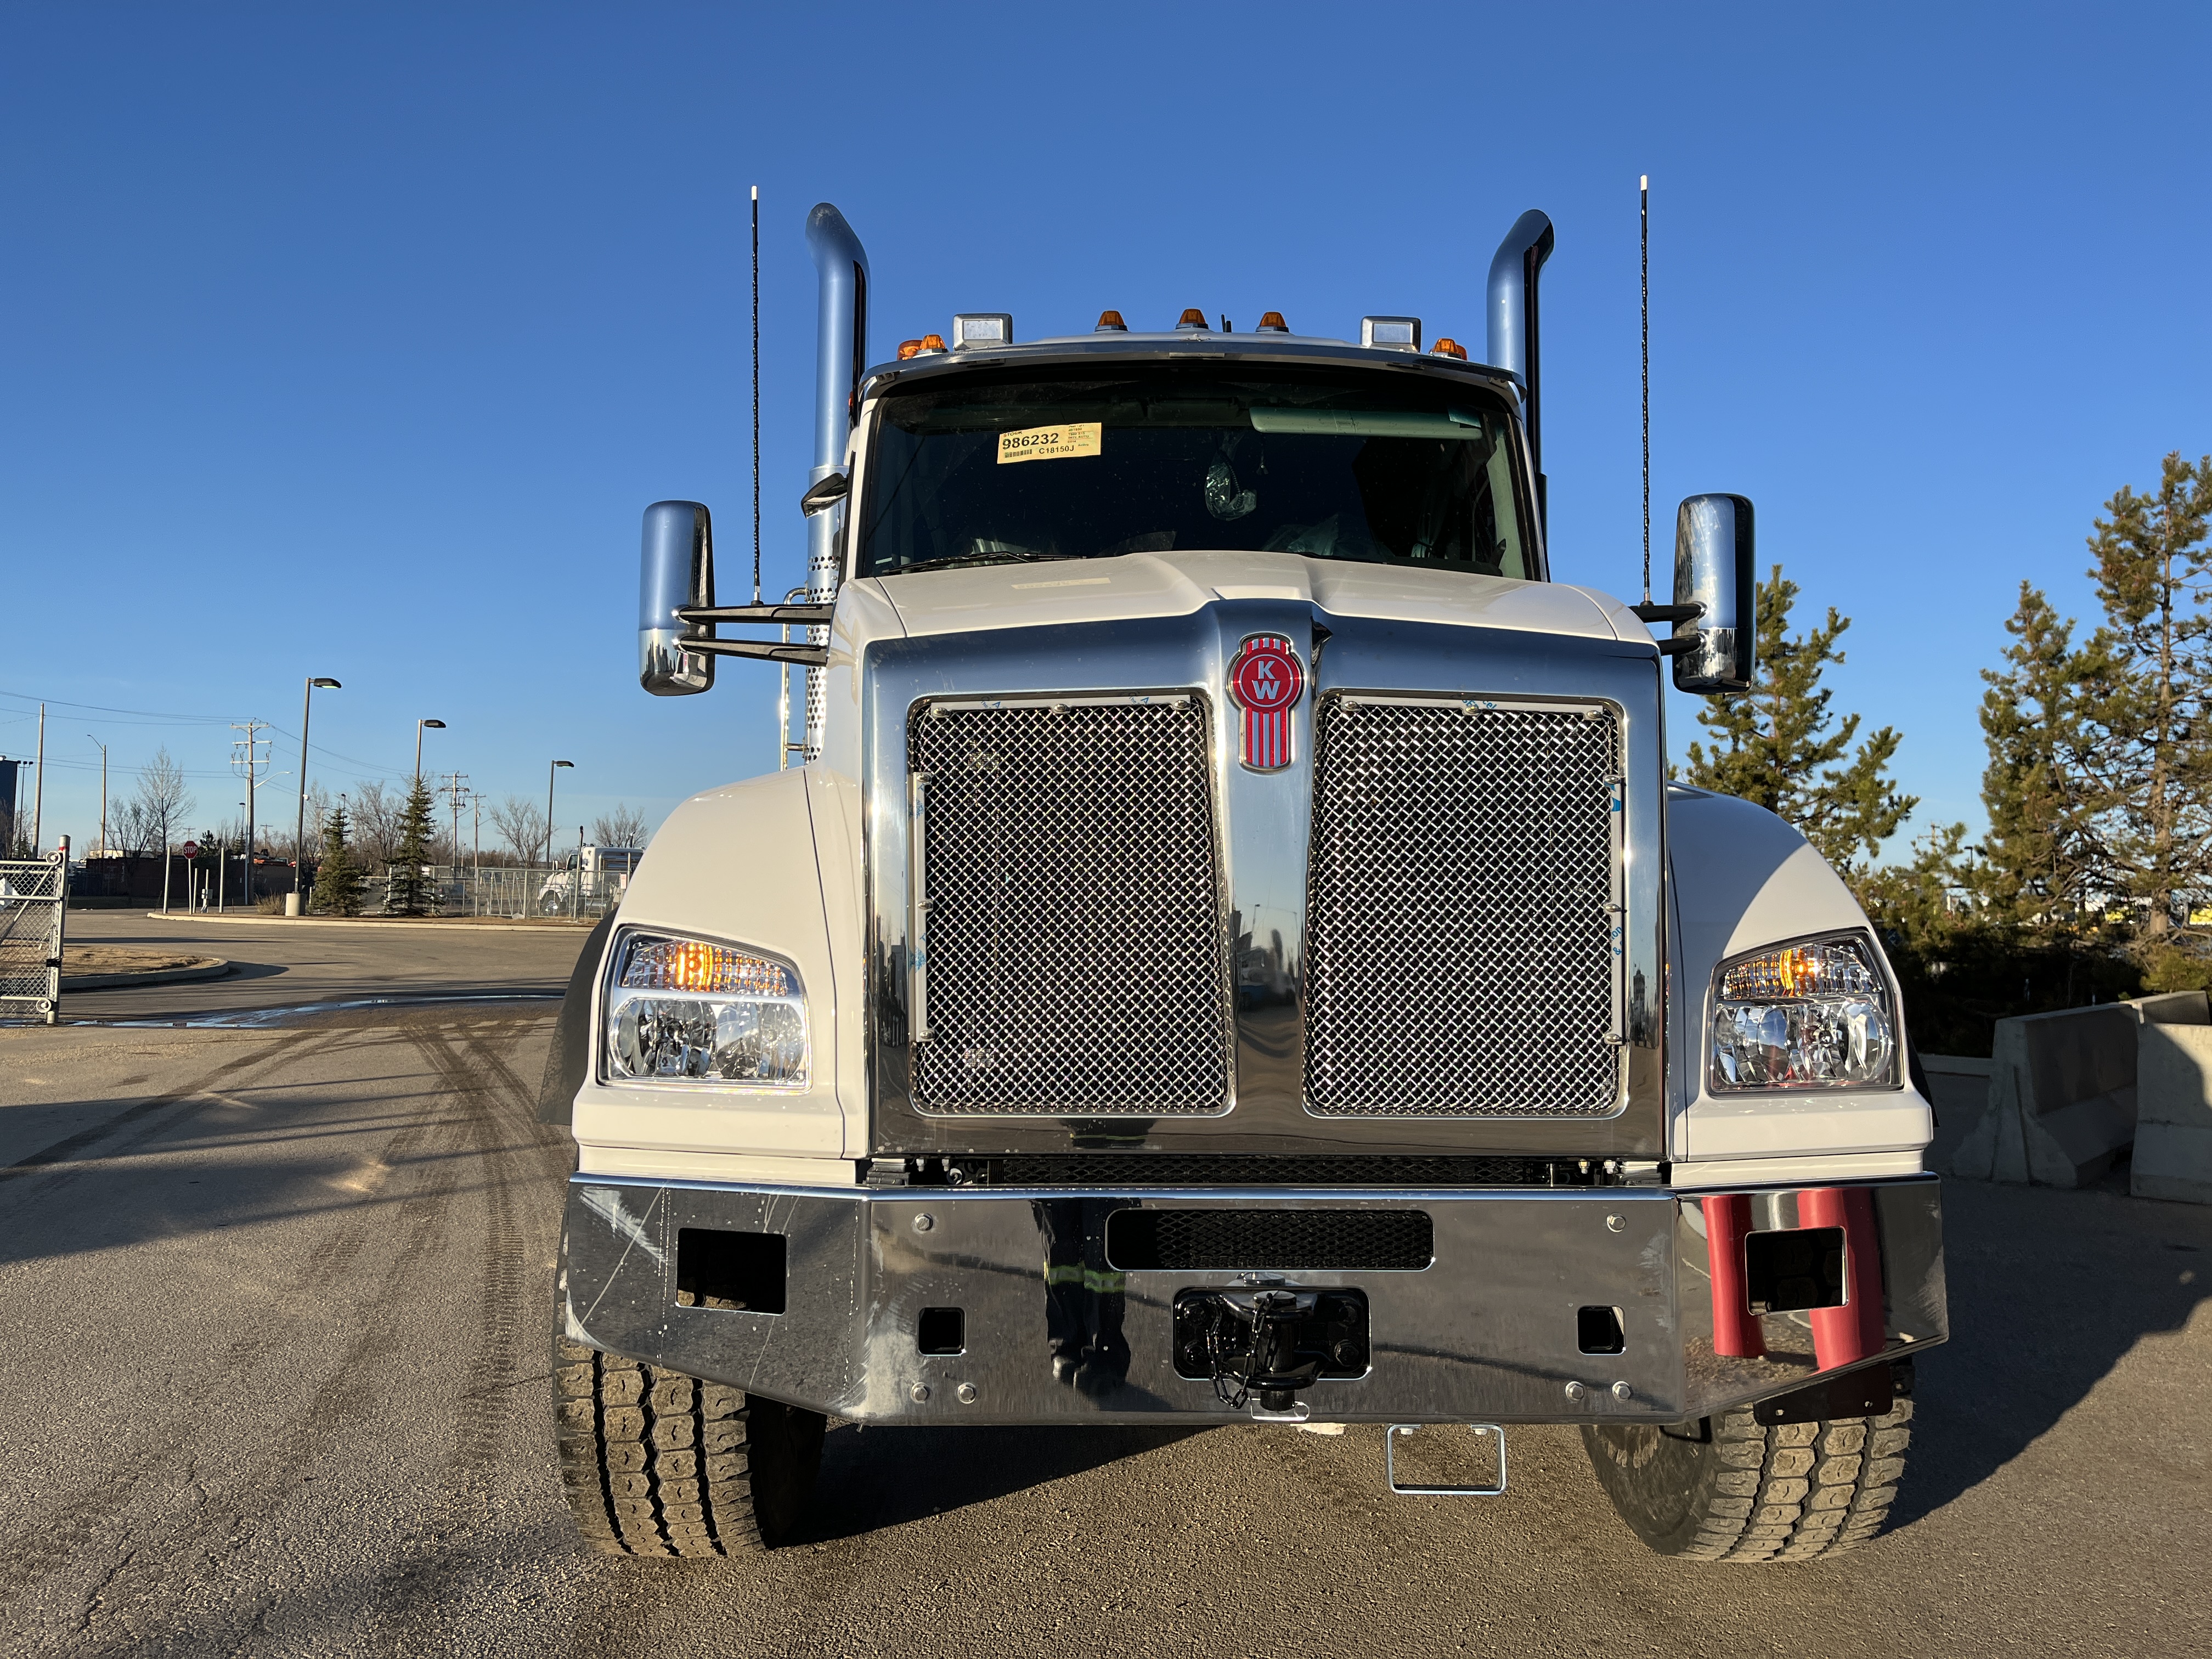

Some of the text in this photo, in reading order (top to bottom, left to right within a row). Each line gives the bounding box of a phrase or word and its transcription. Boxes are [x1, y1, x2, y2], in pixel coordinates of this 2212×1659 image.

[1002, 433, 1059, 450] 986232
[1039, 445, 1074, 454] C18150J
[184, 846, 197, 854] STOP
